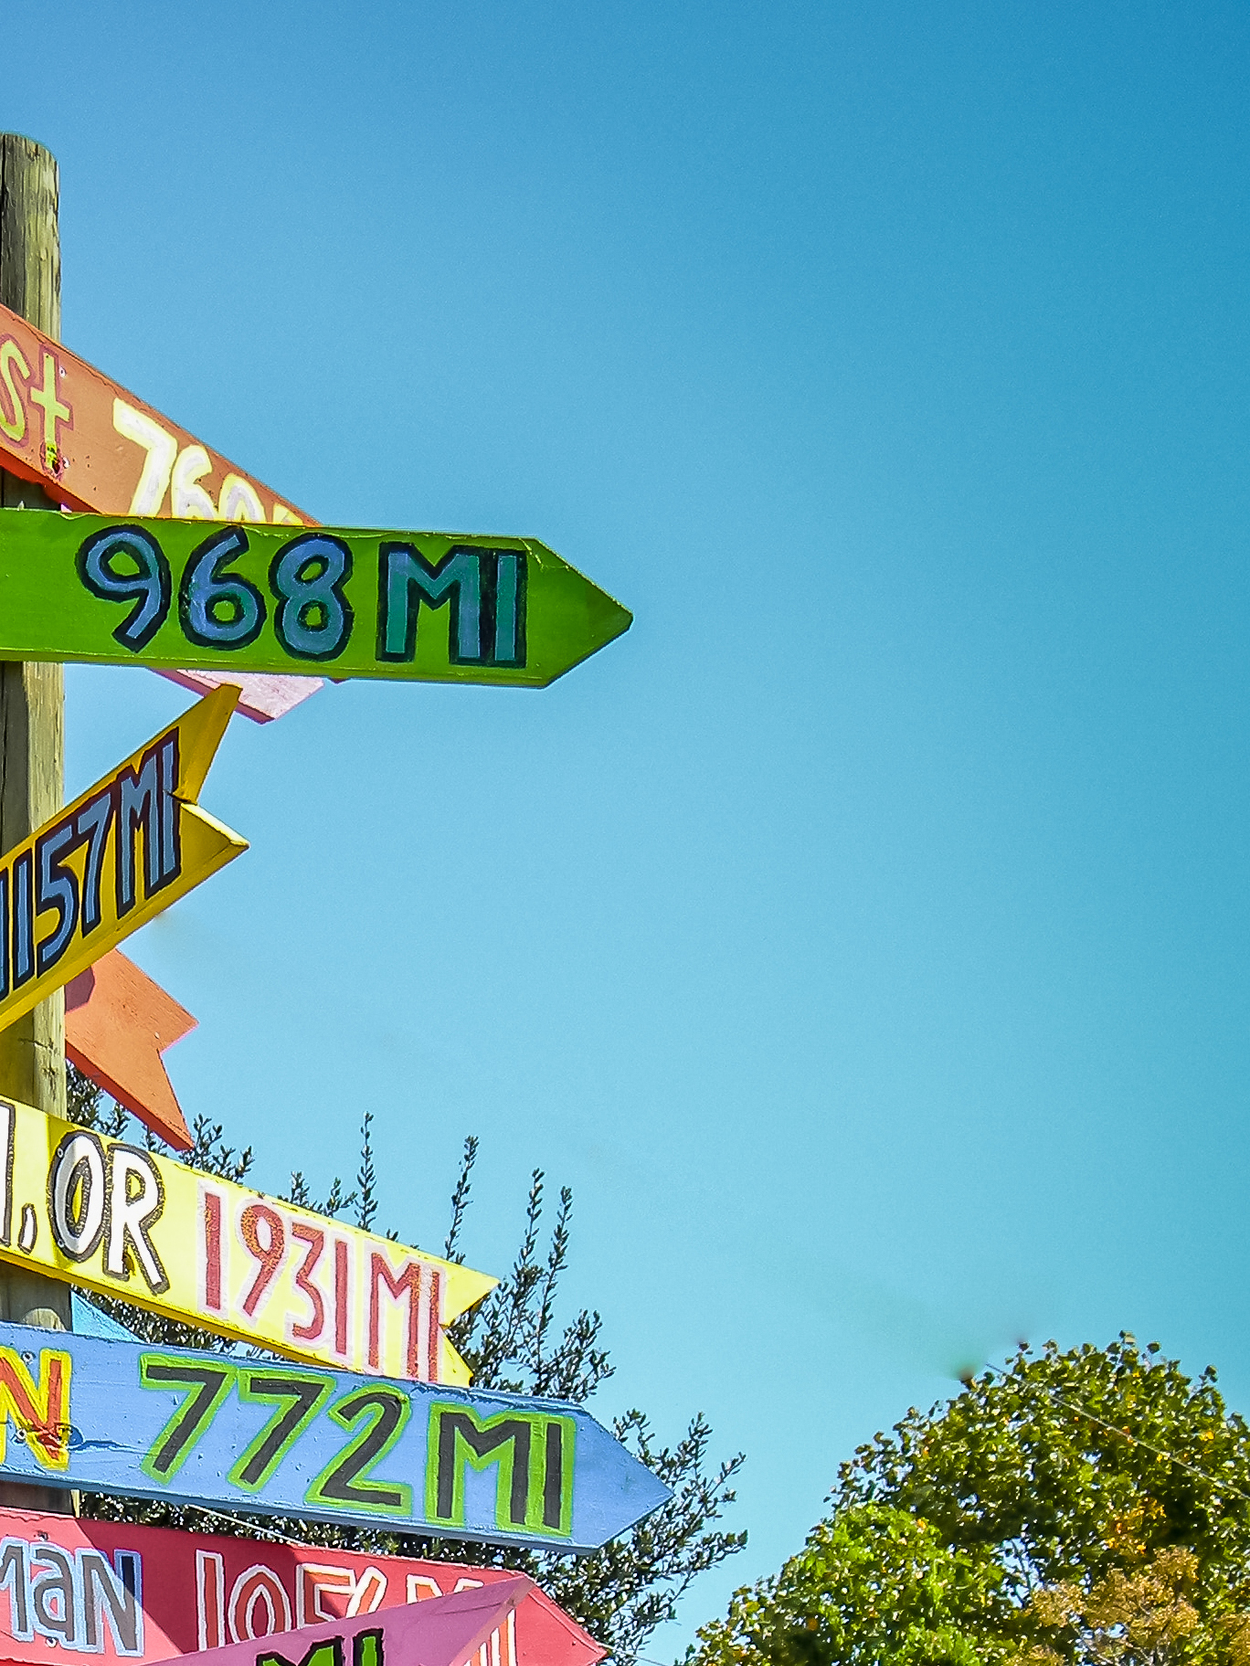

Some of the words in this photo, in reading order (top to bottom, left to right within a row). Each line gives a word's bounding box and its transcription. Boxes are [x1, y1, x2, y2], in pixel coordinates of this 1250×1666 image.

[74, 523, 354, 662] 968
[375, 540, 528, 670] MI
[48, 1130, 169, 1295] OR
[139, 1352, 412, 1516] 772
[424, 1401, 577, 1537] MI
